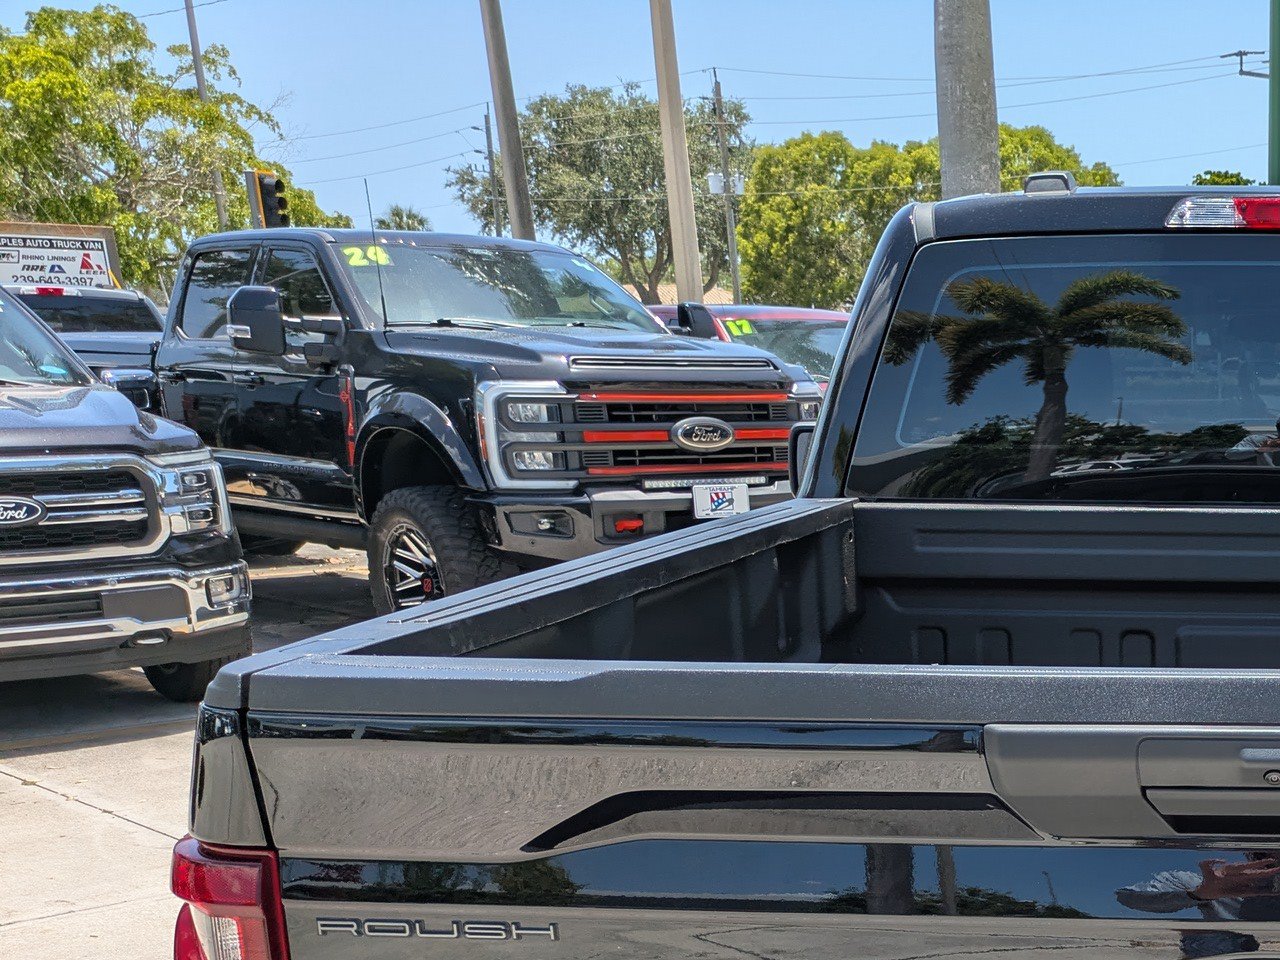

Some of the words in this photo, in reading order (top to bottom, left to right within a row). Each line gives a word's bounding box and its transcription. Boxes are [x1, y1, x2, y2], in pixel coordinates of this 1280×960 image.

[0, 238, 24, 247] PLES
[25, 239, 51, 248] AUTO
[53, 241, 82, 250] TRUCK
[83, 242, 102, 250] VAN
[12, 275, 94, 287] 239-643-3397
[691, 426, 721, 442] Ford
[316, 917, 560, 941] ROUSH
